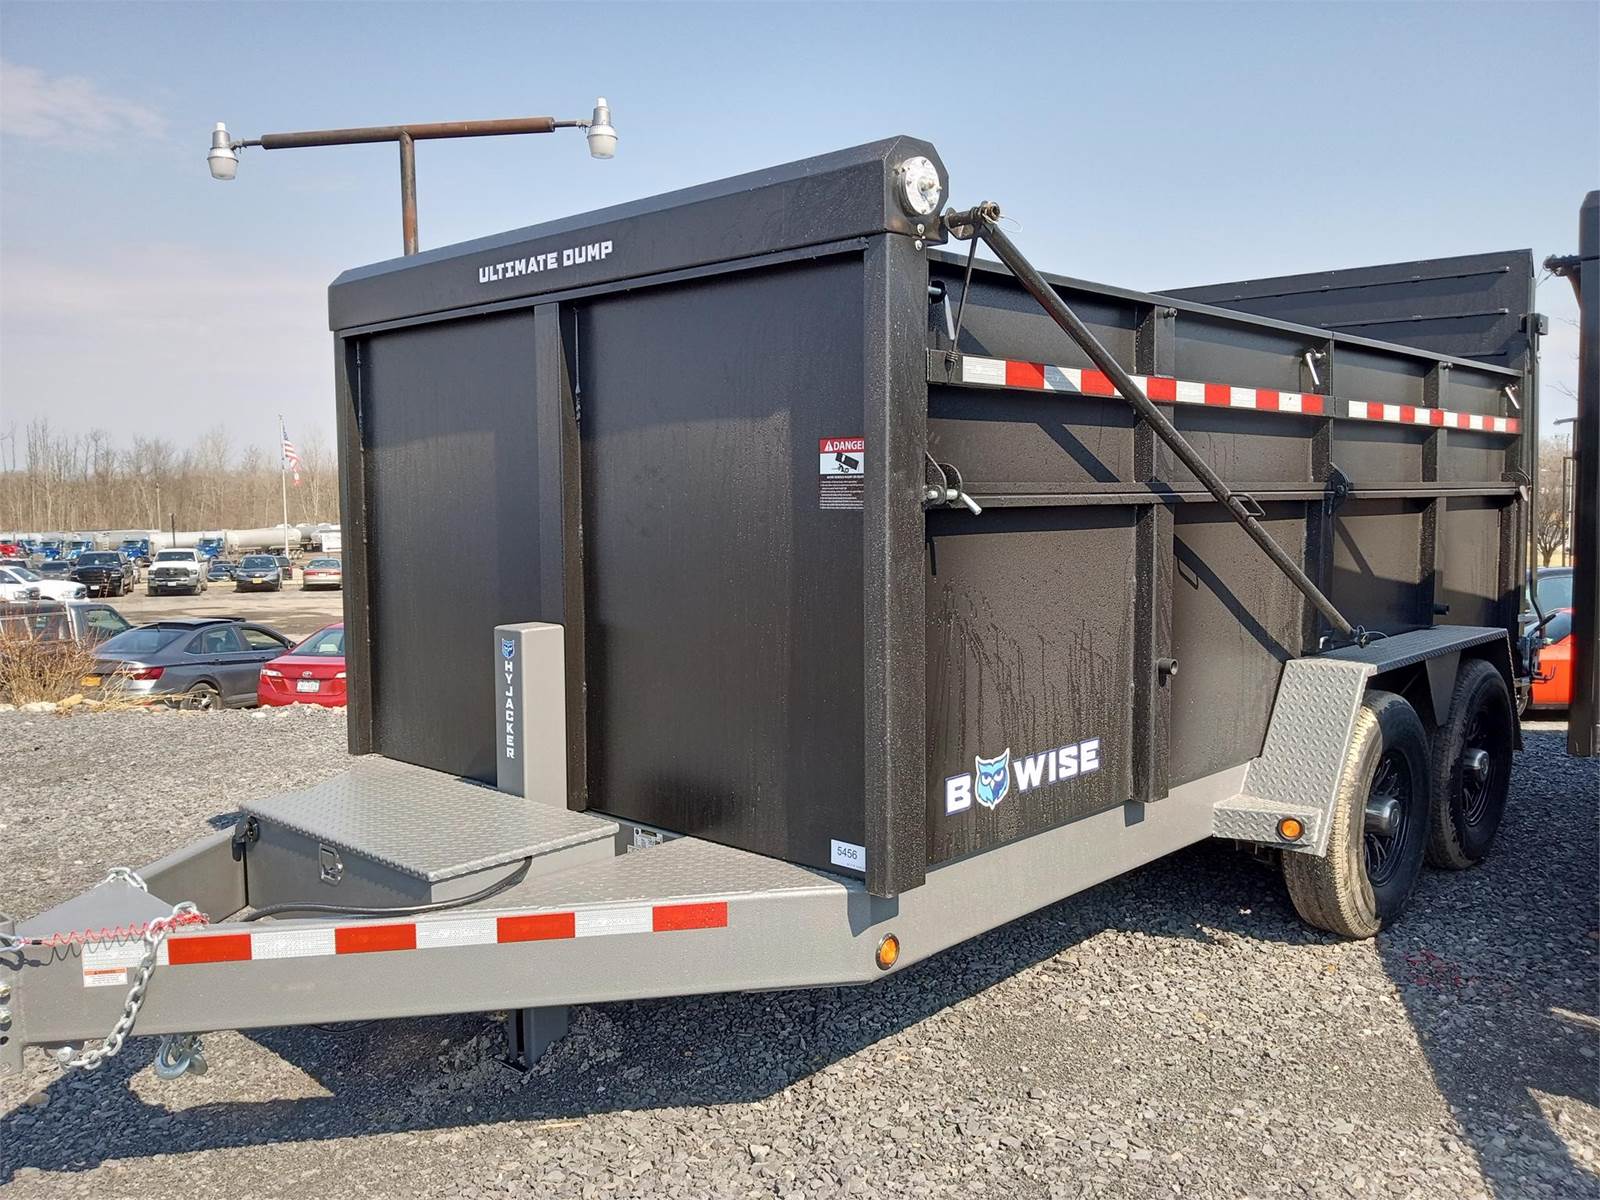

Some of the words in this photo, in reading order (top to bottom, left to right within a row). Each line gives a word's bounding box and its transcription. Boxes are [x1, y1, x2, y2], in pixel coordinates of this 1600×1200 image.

[479, 251, 558, 283] ULTIMATE
[562, 240, 613, 267] DUMP
[504, 660, 515, 759] HYJACKER
[837, 846, 858, 860] 5456
